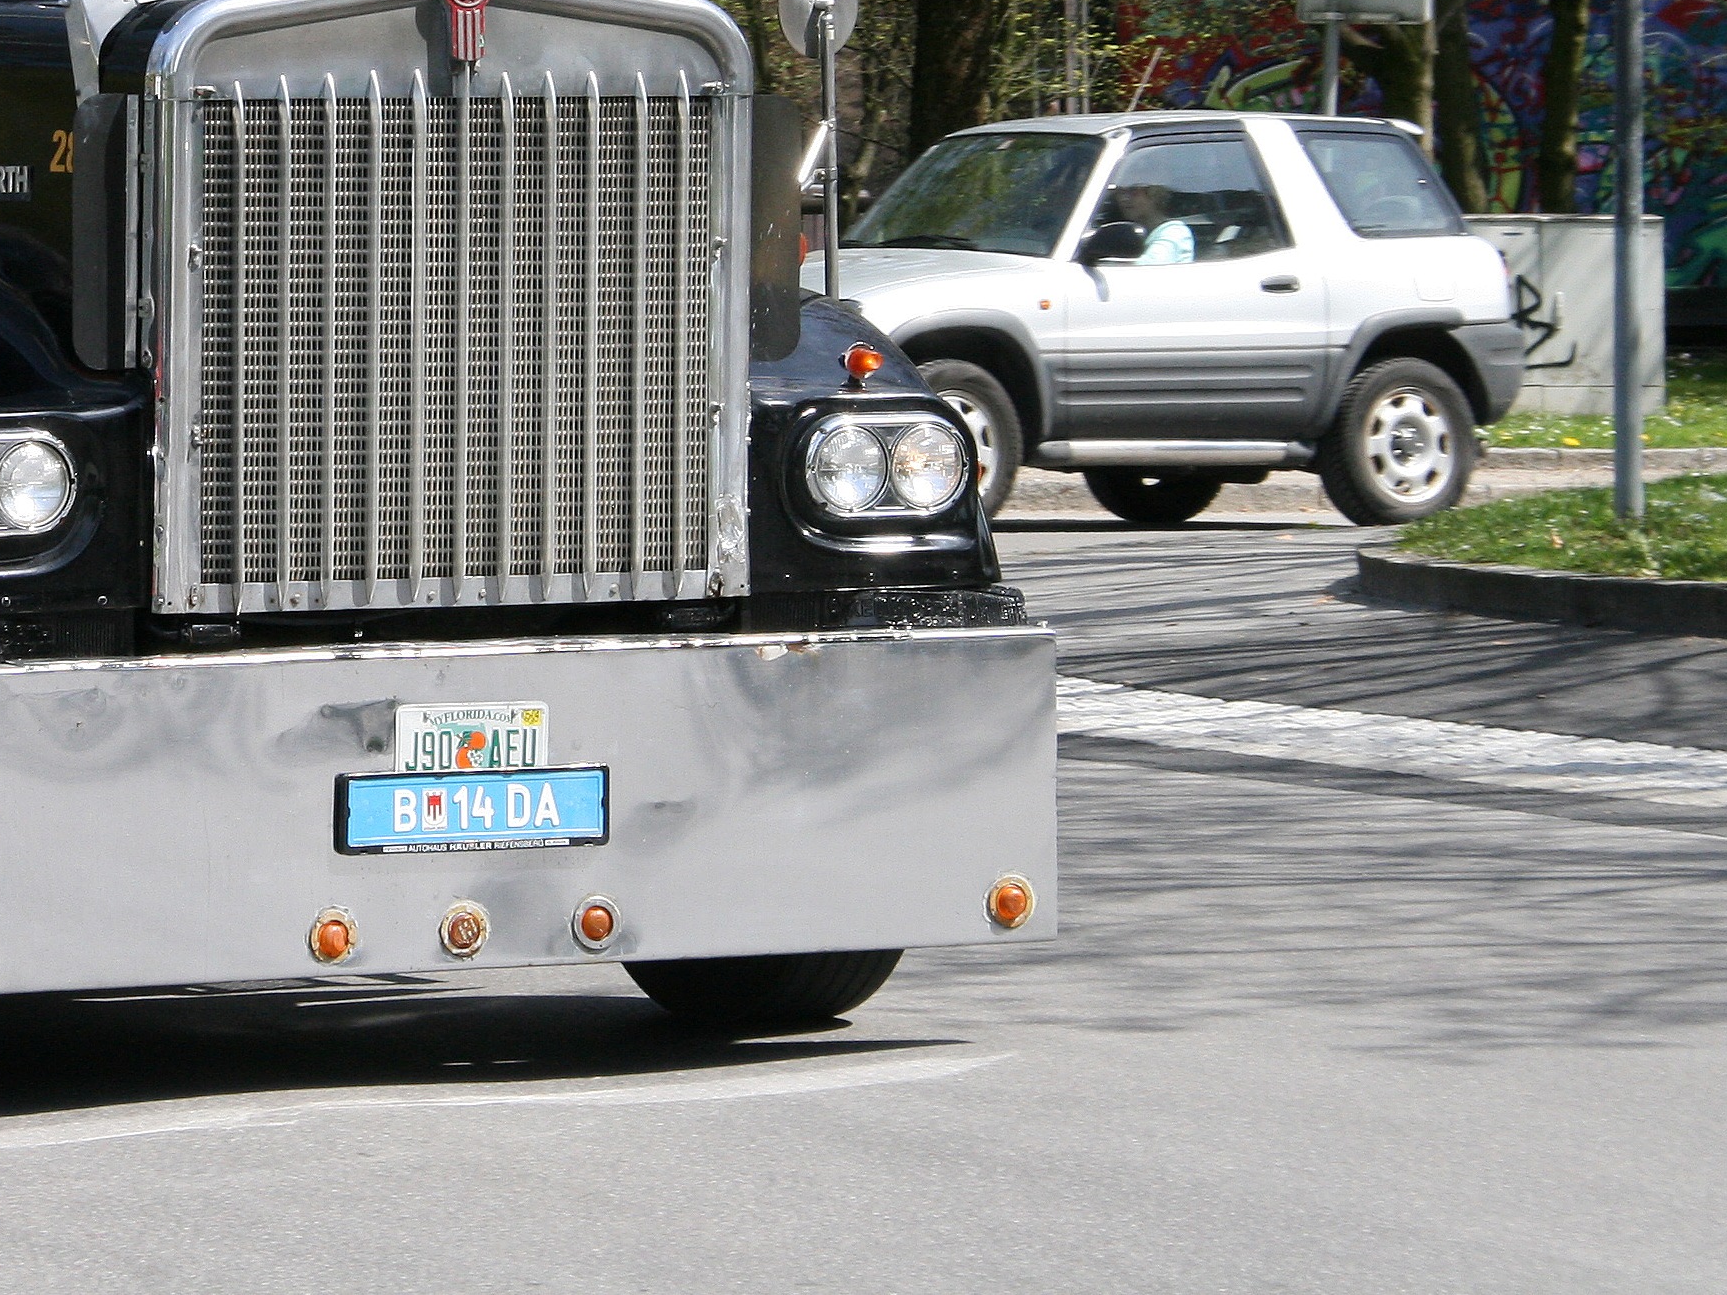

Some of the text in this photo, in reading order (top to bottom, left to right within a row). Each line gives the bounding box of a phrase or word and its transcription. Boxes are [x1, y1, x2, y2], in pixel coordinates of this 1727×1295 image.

[393, 783, 561, 833] B 14 DA
[408, 843, 448, 853] AUTOHAUS
